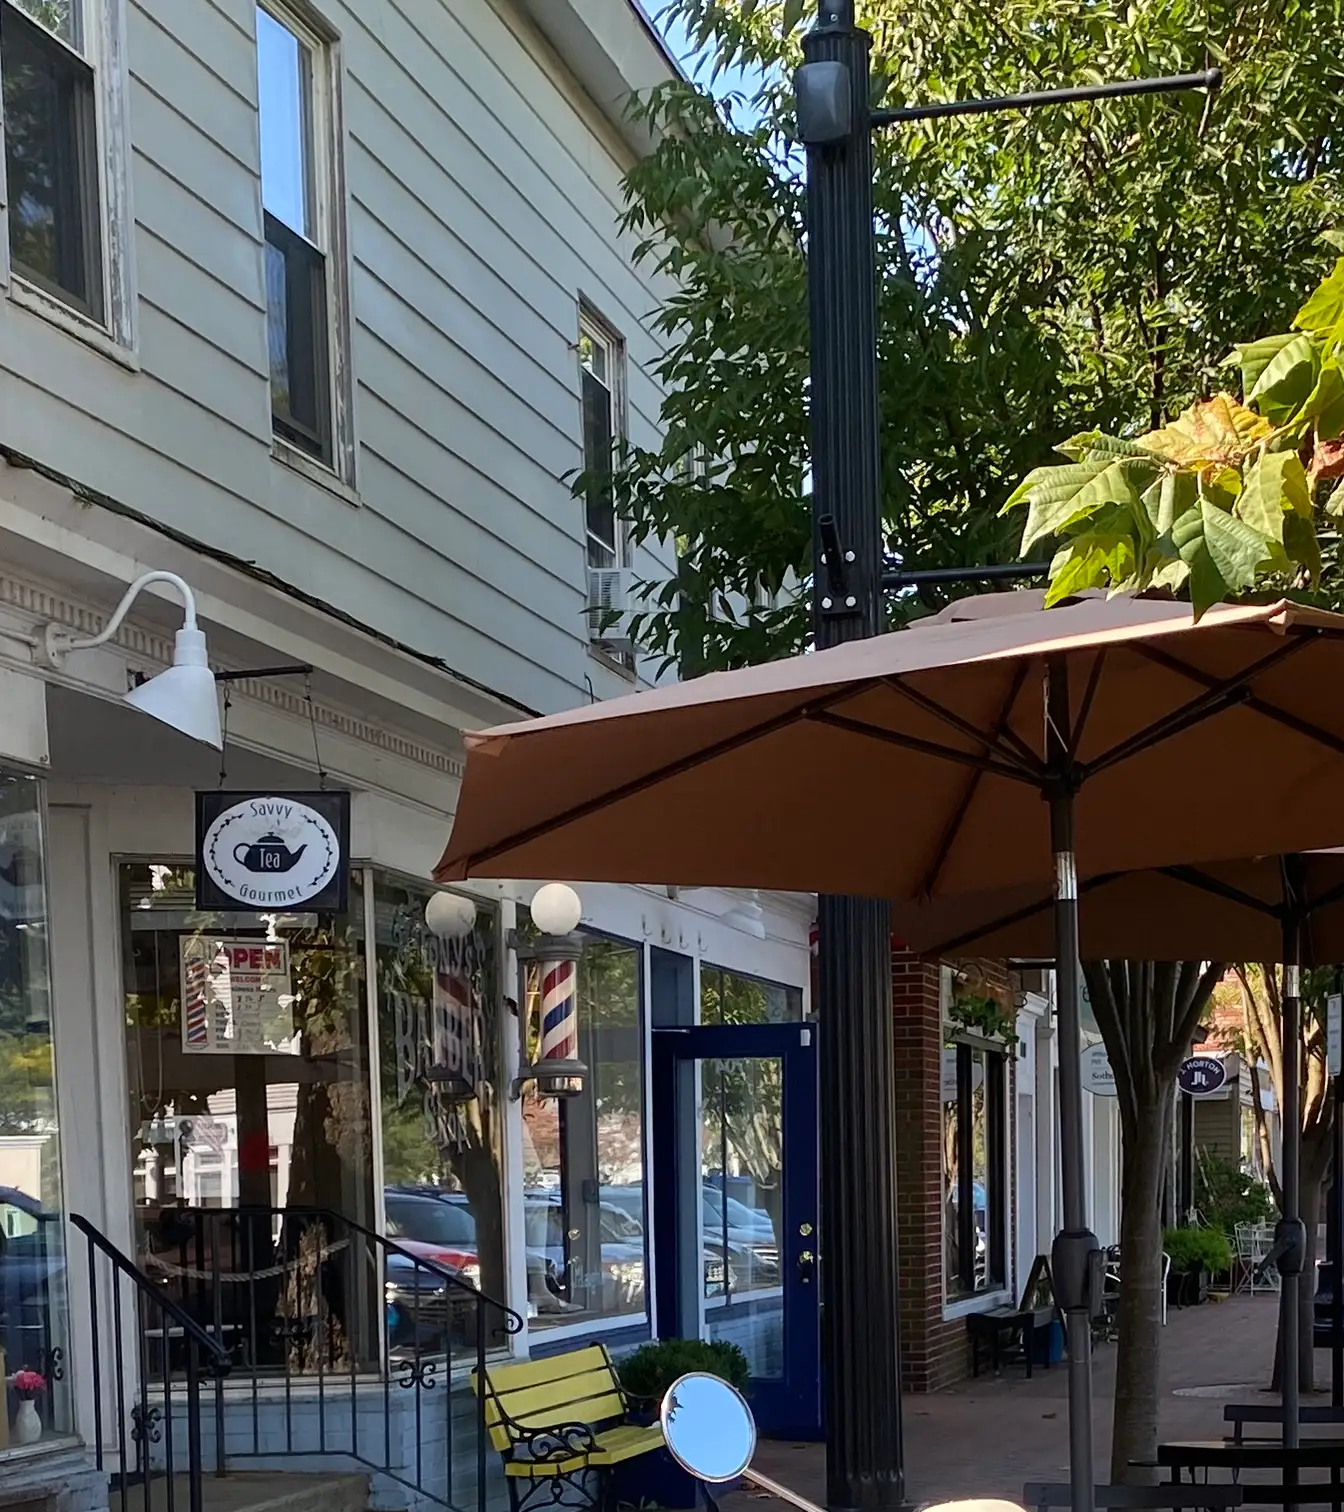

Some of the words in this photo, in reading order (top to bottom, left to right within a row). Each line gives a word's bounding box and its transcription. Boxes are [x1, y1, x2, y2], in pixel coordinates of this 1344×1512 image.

[250, 802, 293, 819] Savvy
[259, 848, 281, 868] Tea
[239, 883, 303, 902] Gourmet
[1187, 1060, 1221, 1074] HORTON
